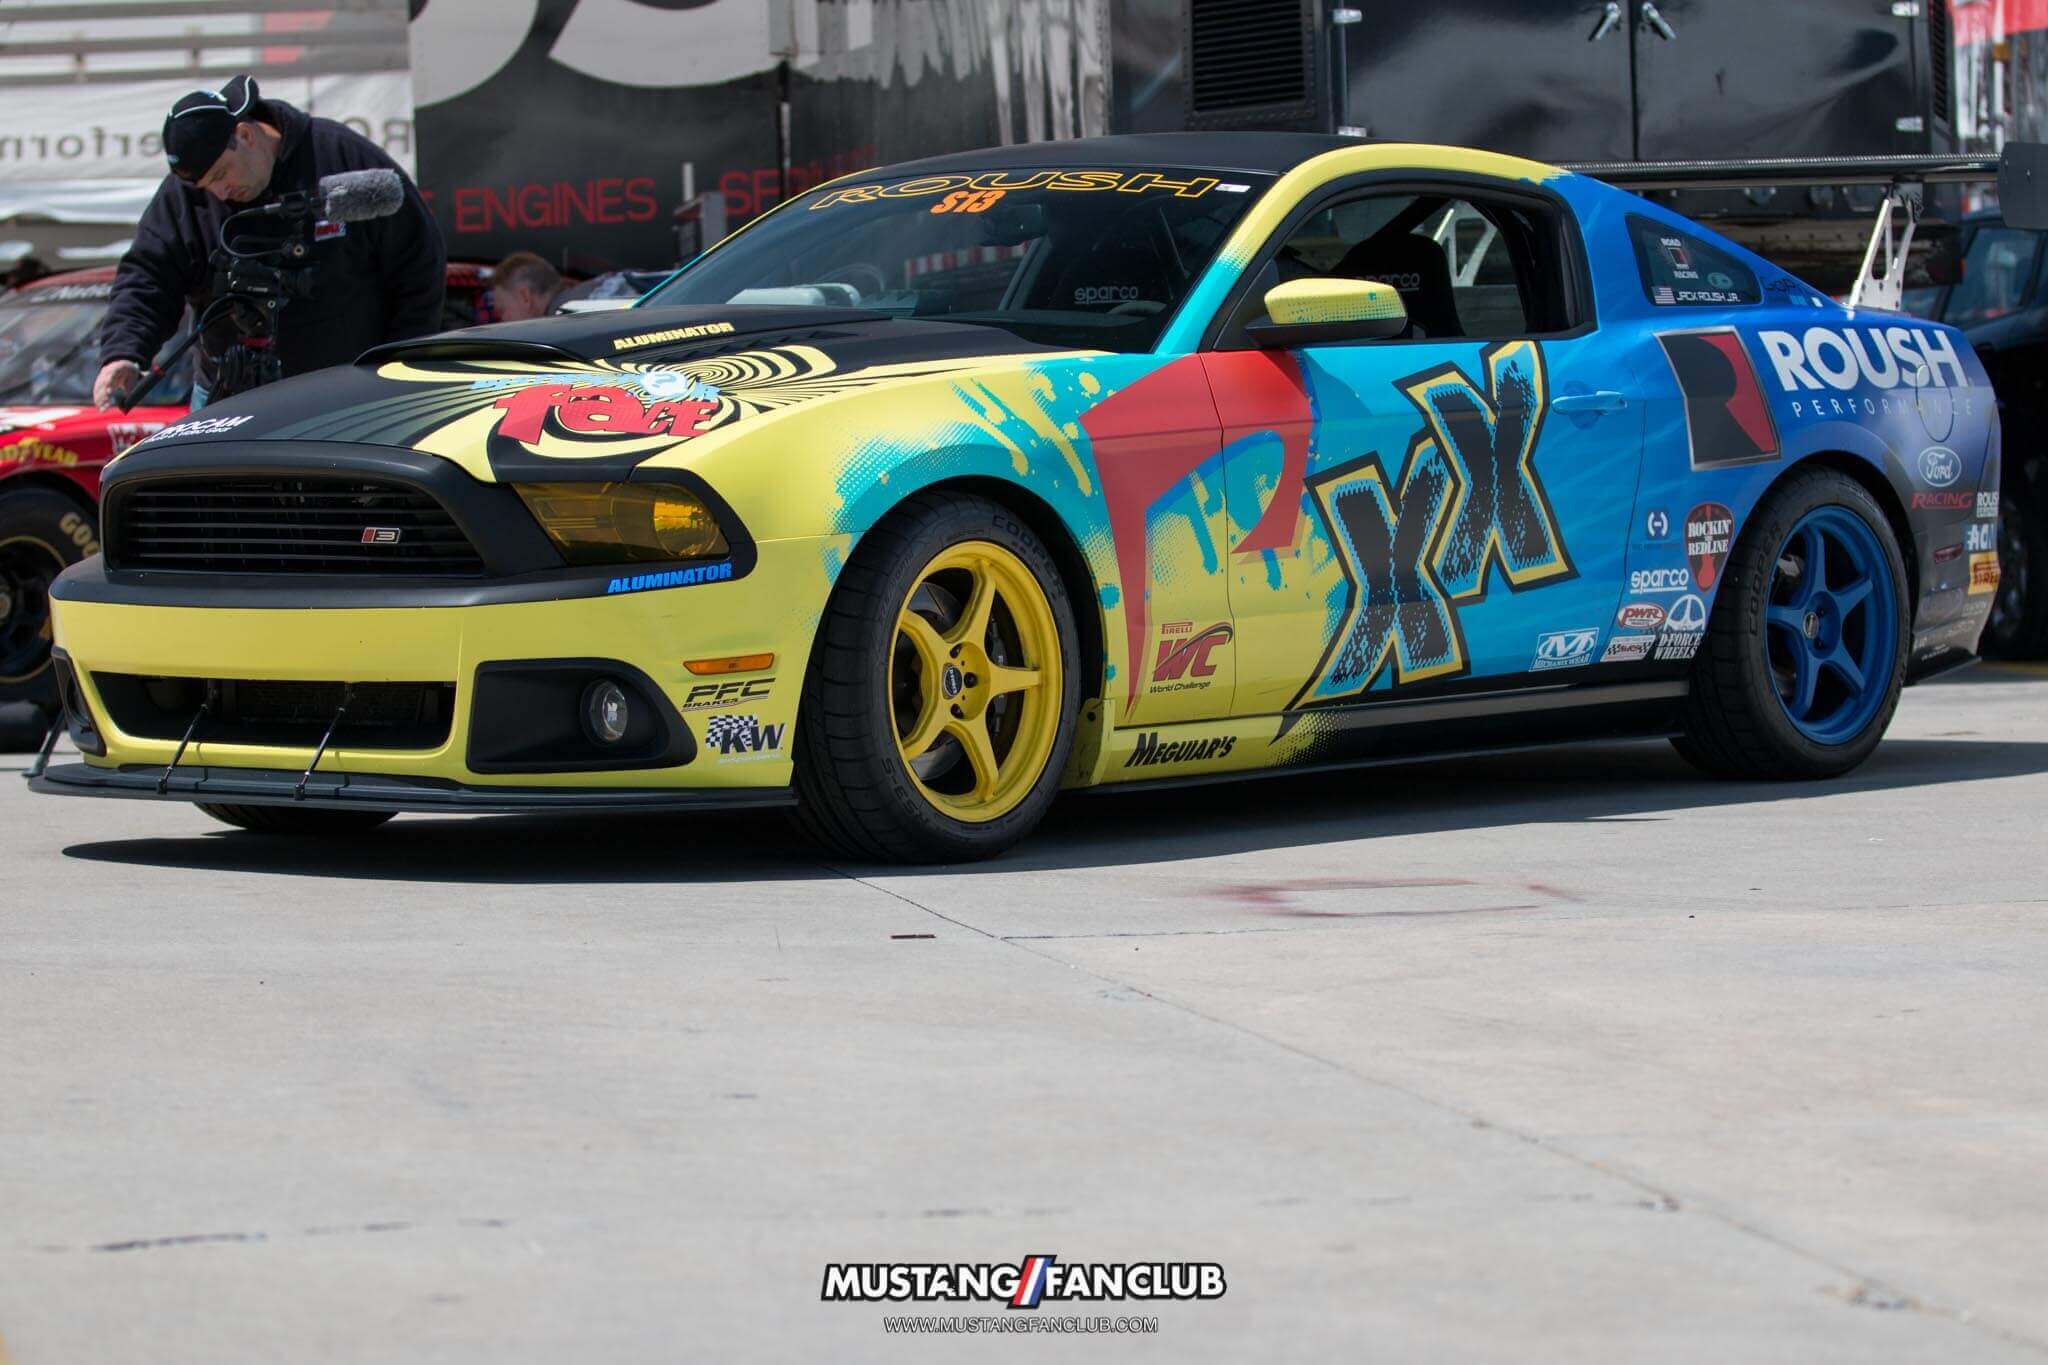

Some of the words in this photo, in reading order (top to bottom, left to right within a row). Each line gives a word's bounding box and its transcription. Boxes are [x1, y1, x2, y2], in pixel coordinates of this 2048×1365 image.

[809, 171, 1219, 210] ROUSH
[930, 190, 1006, 214] S13
[456, 177, 657, 233] ENGINES
[1074, 285, 1138, 304] sparco
[613, 321, 736, 351] ALUMINATOR
[1757, 326, 1969, 392] ROUSH
[1926, 451, 1954, 480] Ford
[1911, 490, 1974, 510] RACING
[1976, 490, 1999, 508] ROUS
[1687, 519, 1731, 538] ROCKIN'
[1688, 540, 1728, 556] REDLINE
[607, 562, 733, 594] ALUMINATOR
[1630, 568, 1689, 594] sparco
[1161, 621, 1193, 635] PIRELLI
[1152, 634, 1229, 682] WC
[1653, 646, 1700, 661] WHEELS
[686, 677, 777, 703] PFC
[1150, 684, 1174, 694] World
[1174, 681, 1212, 694] Challenge
[683, 698, 739, 708] BRAKES
[719, 722, 786, 755] KW
[1124, 731, 1238, 768] MEGUIAR'S
